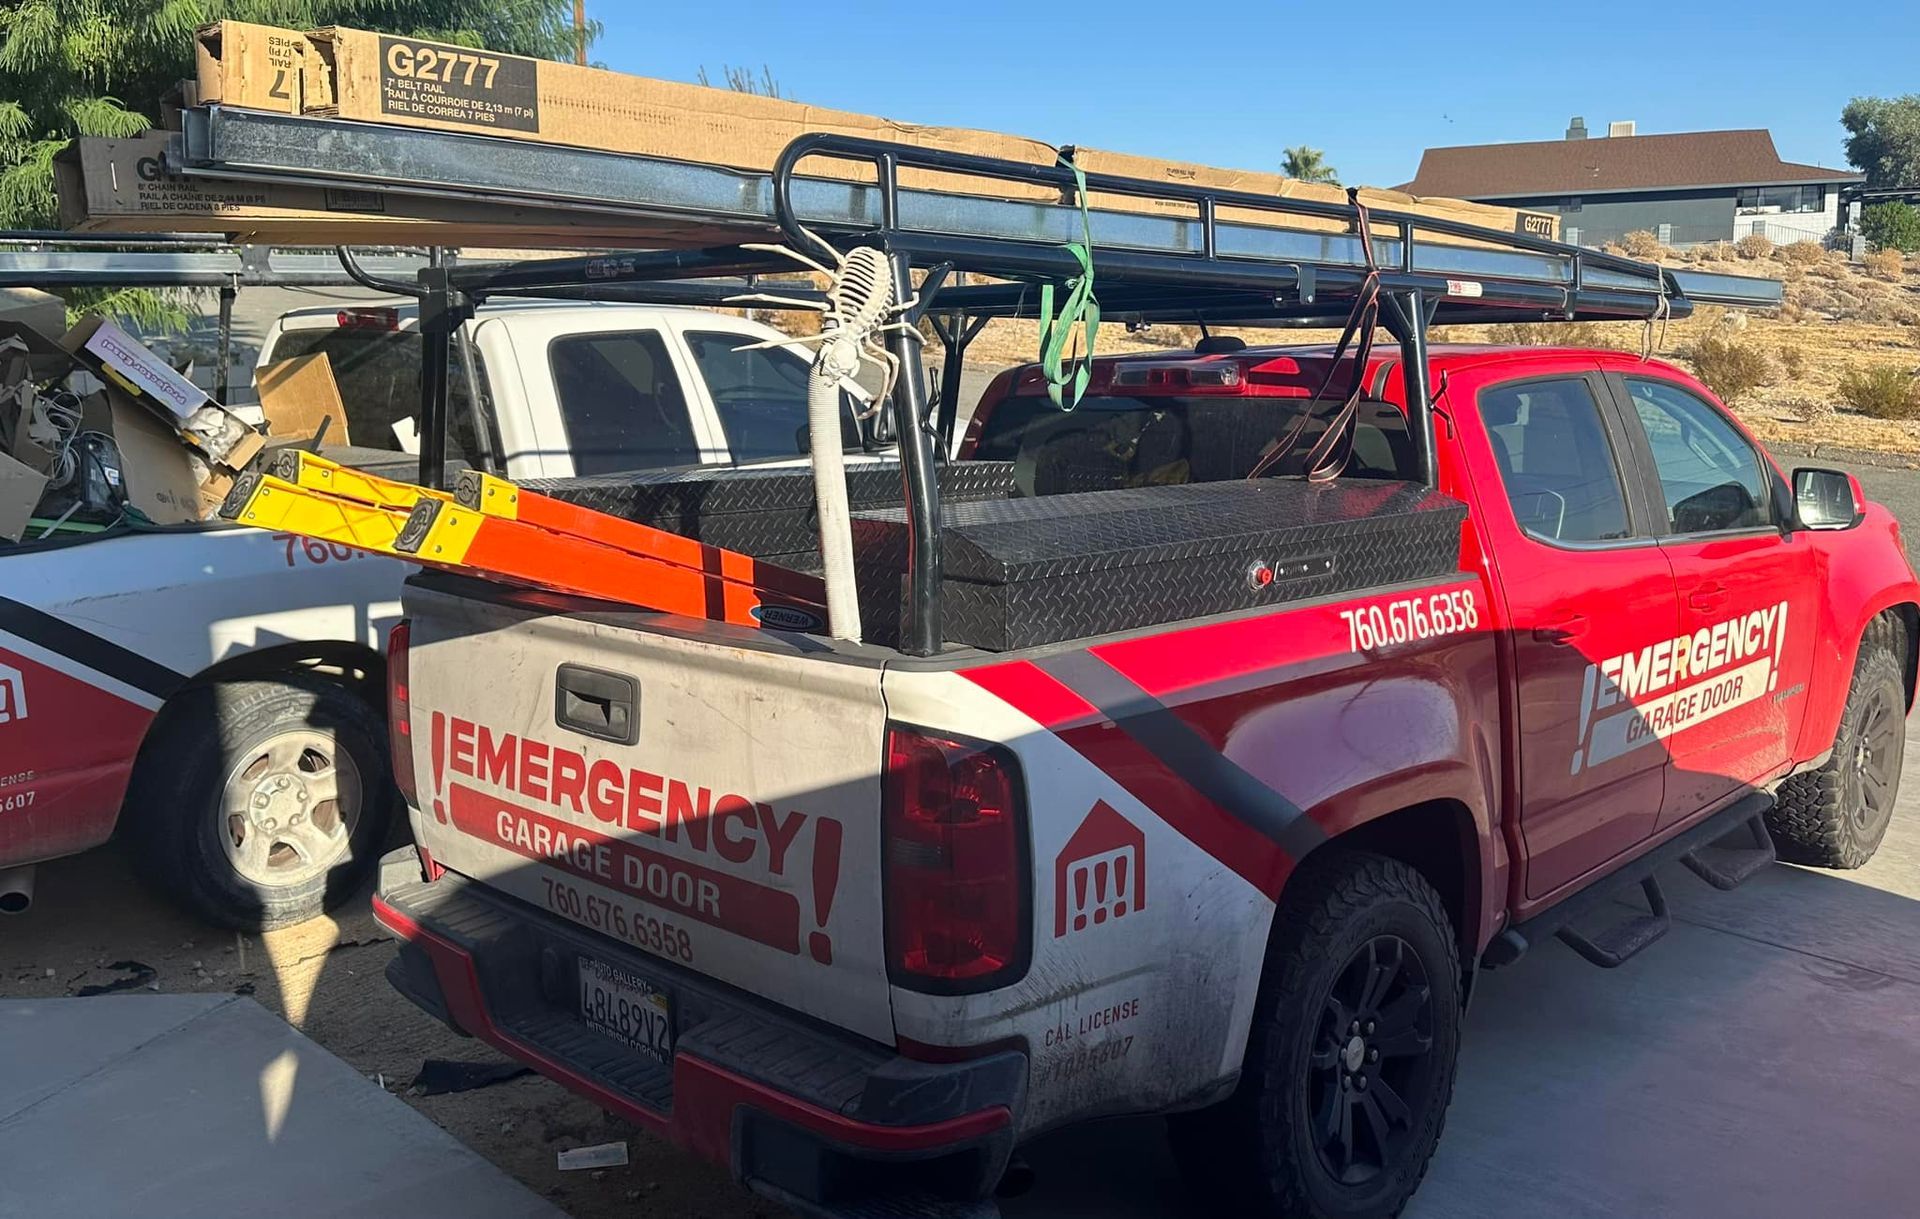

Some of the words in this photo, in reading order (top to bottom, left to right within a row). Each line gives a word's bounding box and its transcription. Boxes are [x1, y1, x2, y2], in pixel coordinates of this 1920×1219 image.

[387, 43, 500, 89] G2777
[269, 69, 290, 99] 7
[397, 79, 423, 91] BELT
[423, 82, 446, 94] RAIL
[388, 88, 410, 101] RAIL
[420, 93, 470, 109] COURROIE
[471, 100, 484, 110] DE
[485, 102, 503, 113] 2,13
[504, 106, 513, 114] m
[514, 106, 523, 117] (7
[523, 108, 535, 119] pi)
[388, 100, 410, 112] RIEL
[411, 103, 425, 113] DE
[426, 105, 467, 119] CORREA
[467, 110, 474, 119] 7
[475, 111, 496, 122] PIES
[140, 191, 160, 201] RAIL
[147, 183, 176, 192] CHAIN
[177, 183, 199, 192] RAIL
[140, 201, 163, 211] RIEL
[163, 202, 176, 211] DE
[176, 202, 212, 212] CADENA
[221, 203, 241, 212] PIES
[1524, 215, 1552, 235] G2777
[101, 338, 135, 368] Easel
[134, 362, 188, 406] Projector
[764, 609, 809, 627] WERNER
[1339, 588, 1479, 653] 760.676.6358
[1625, 692, 1699, 744] GARAGE
[1700, 674, 1744, 717] DOOR
[495, 809, 613, 883] GARAGE
[622, 853, 722, 920] DOOR
[541, 875, 694, 964] 760.676.6358
[613, 968, 648, 993] GALLERY
[584, 980, 669, 1054] 48489V2
[1045, 1022, 1073, 1047] CAL
[1079, 998, 1140, 1036] LICENSE
